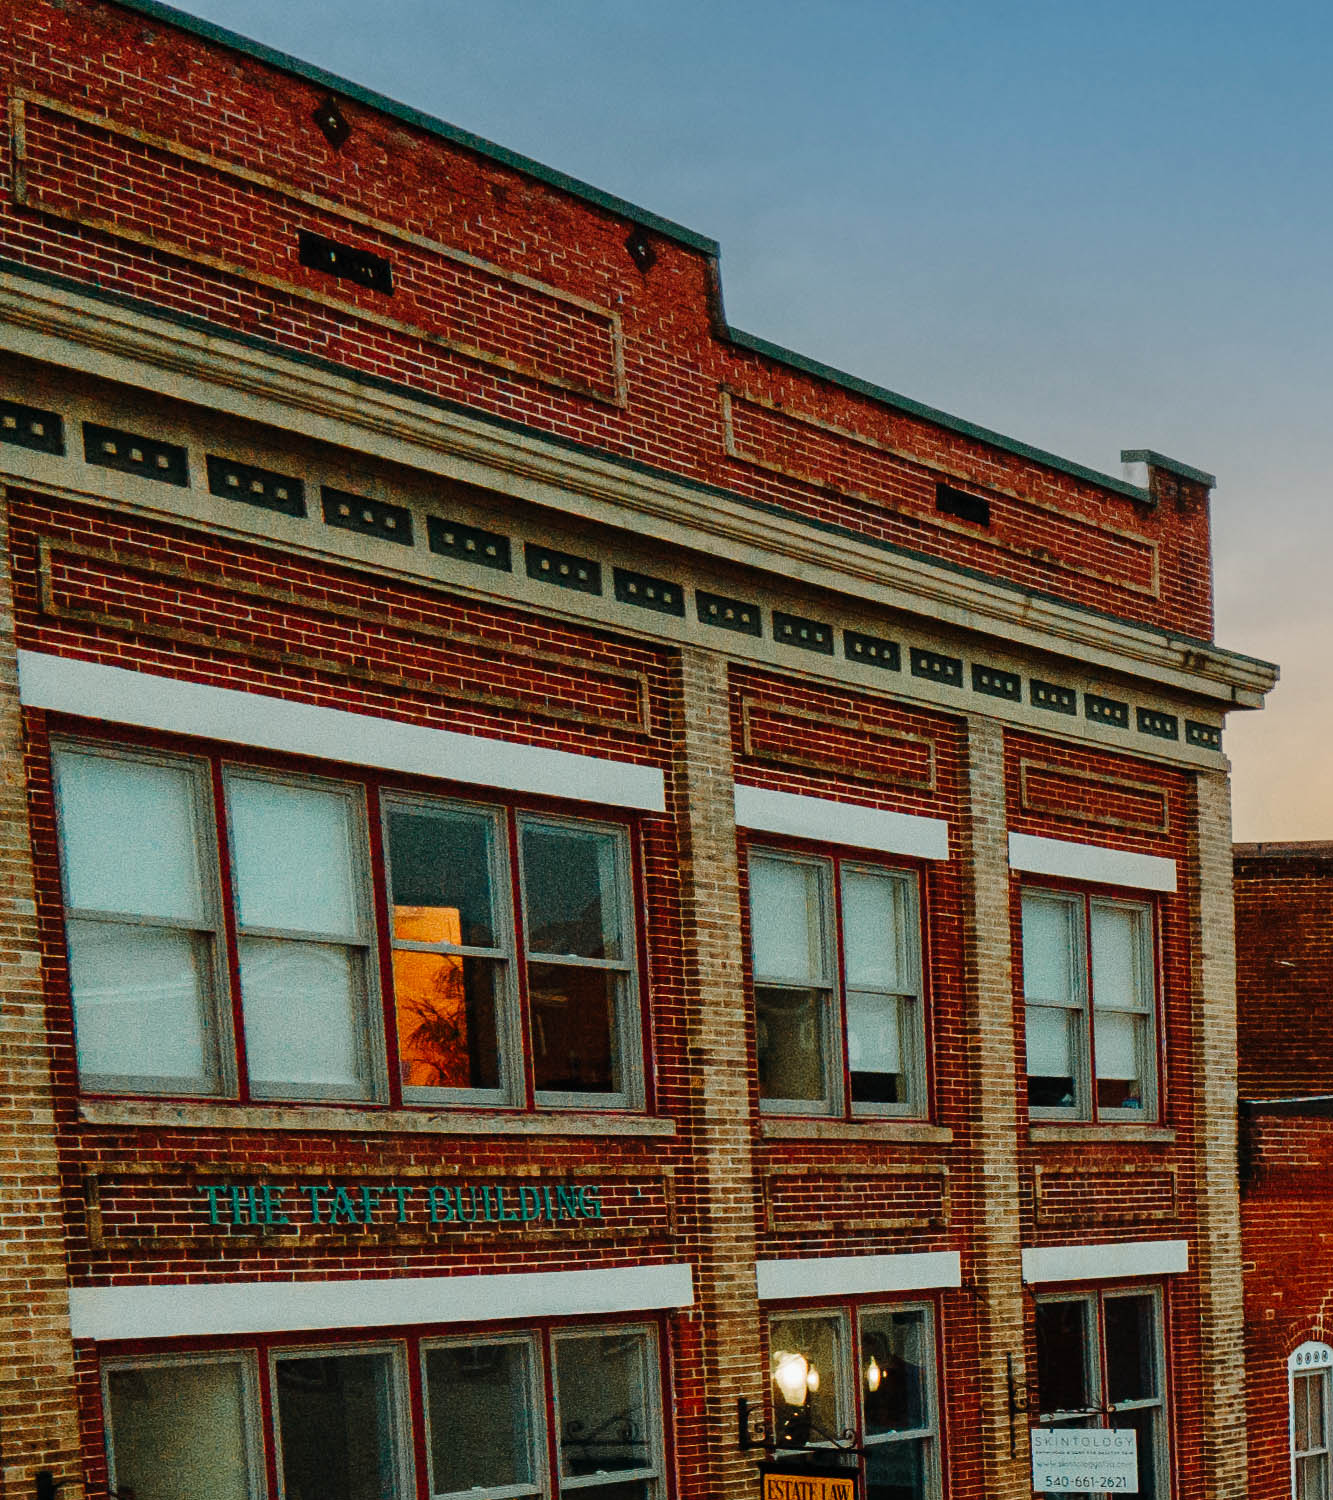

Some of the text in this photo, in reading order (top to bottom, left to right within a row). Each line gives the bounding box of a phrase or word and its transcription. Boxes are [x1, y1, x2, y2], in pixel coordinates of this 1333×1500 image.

[199, 1184, 602, 1225] THE TAFT BUILDING
[1034, 1437, 1134, 1447] SKINTOLOGY
[1045, 1475, 1127, 1488] 540-661-2621
